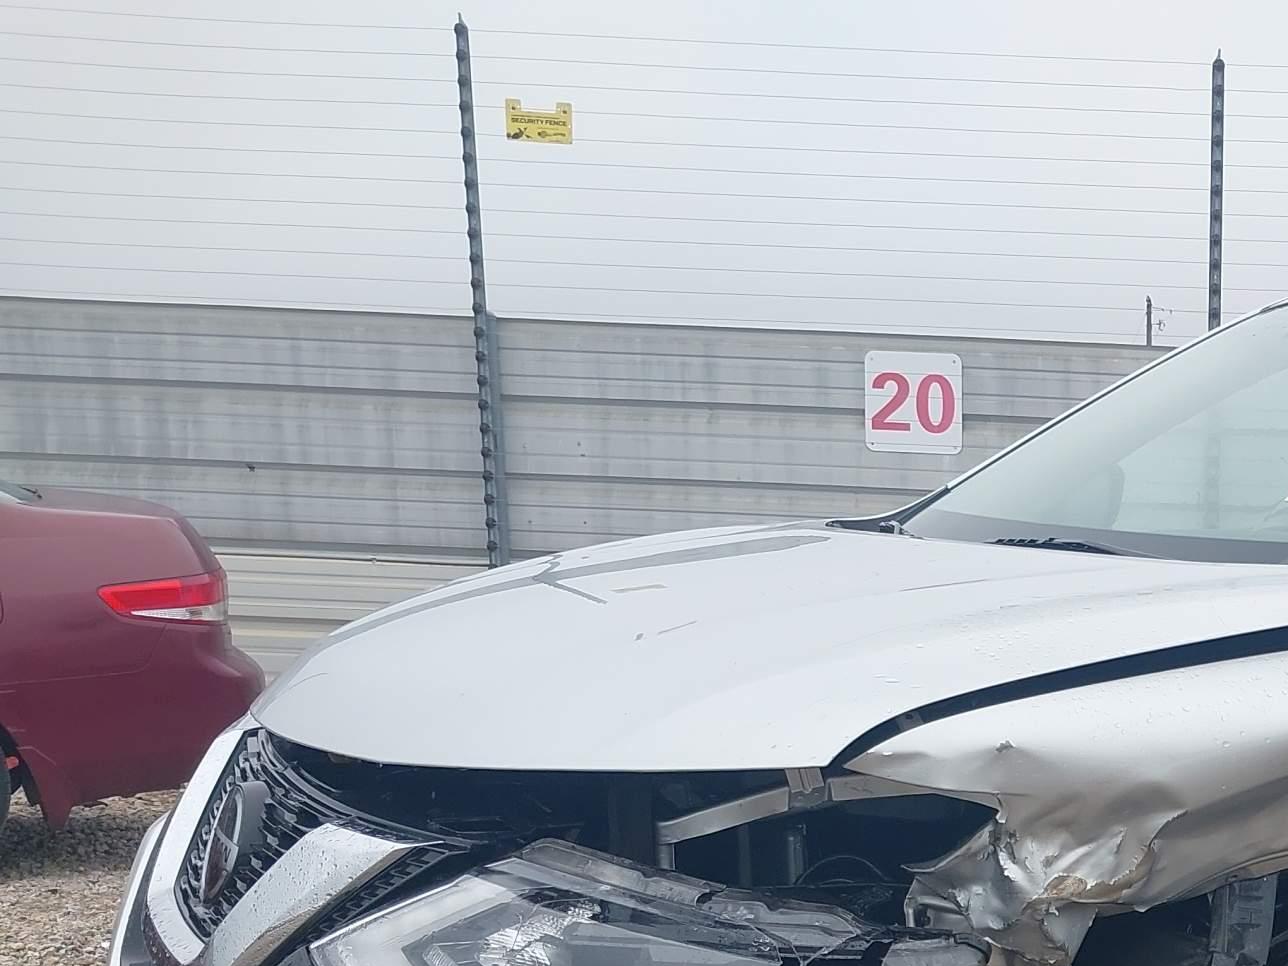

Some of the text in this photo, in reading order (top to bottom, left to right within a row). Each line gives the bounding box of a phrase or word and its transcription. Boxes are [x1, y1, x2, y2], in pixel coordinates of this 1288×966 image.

[511, 117, 567, 127] SECURITY FENCE
[871, 371, 955, 434] 20
